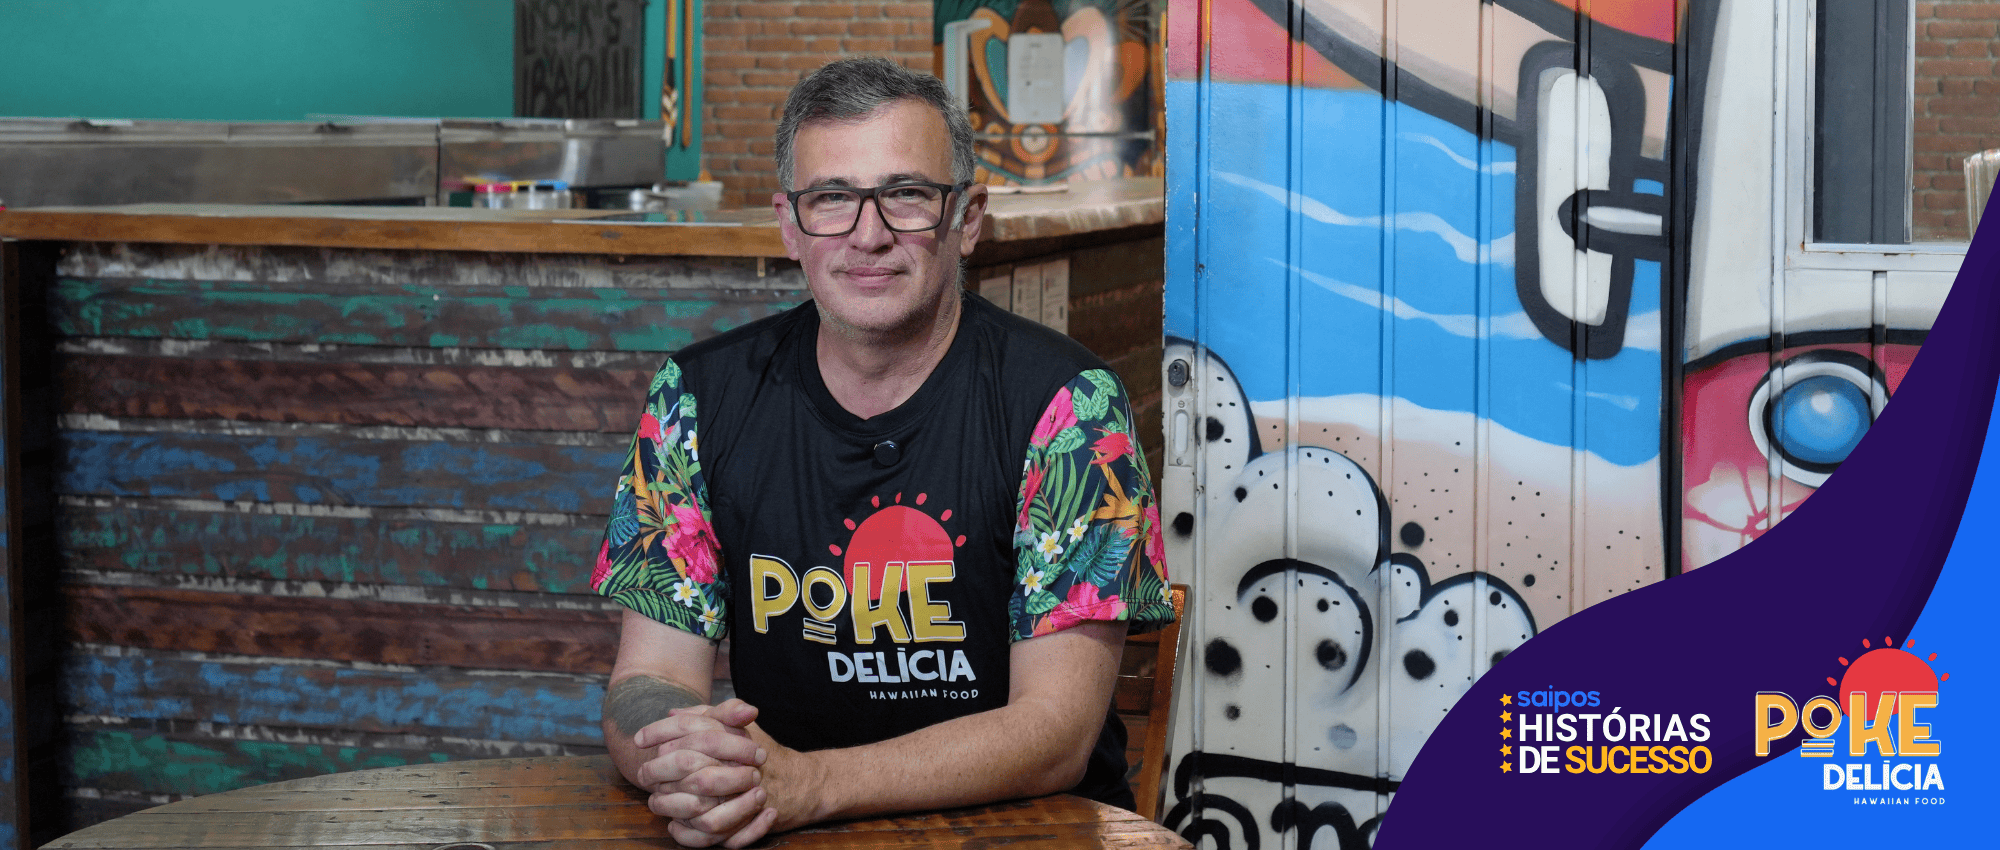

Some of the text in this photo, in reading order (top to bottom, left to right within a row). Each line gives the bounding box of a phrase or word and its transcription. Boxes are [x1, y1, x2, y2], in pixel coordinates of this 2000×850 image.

[749, 553, 967, 646] POKE
[869, 688, 979, 701] HAWAIIAN FOOD
